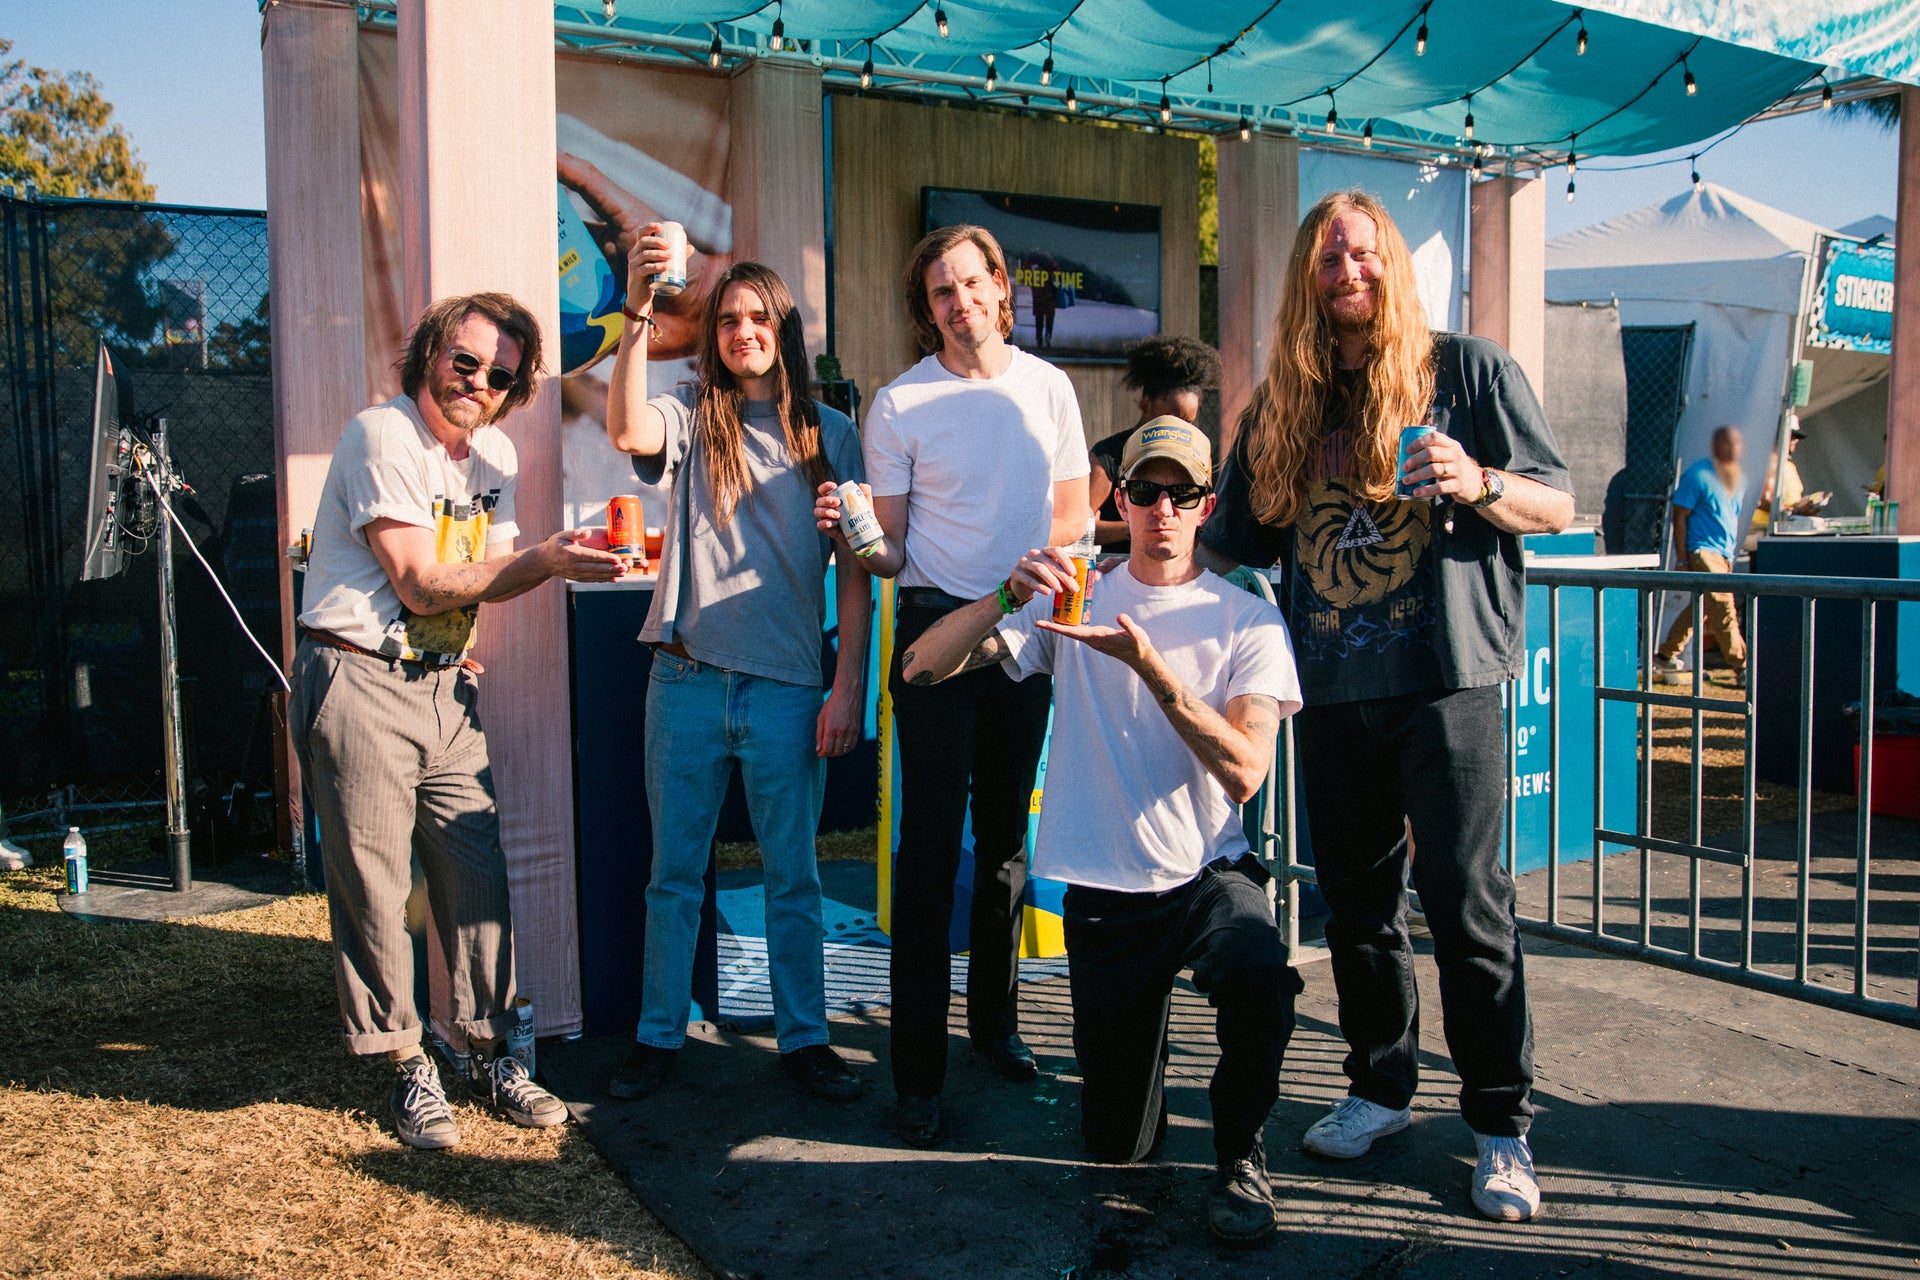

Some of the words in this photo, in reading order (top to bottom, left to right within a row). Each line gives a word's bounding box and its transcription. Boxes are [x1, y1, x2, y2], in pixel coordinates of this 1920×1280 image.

[1015, 268, 1049, 288] PREP
[1053, 271, 1084, 289] TIME
[1143, 429, 1192, 441] Wrangler
[1505, 771, 1551, 799] REWS
